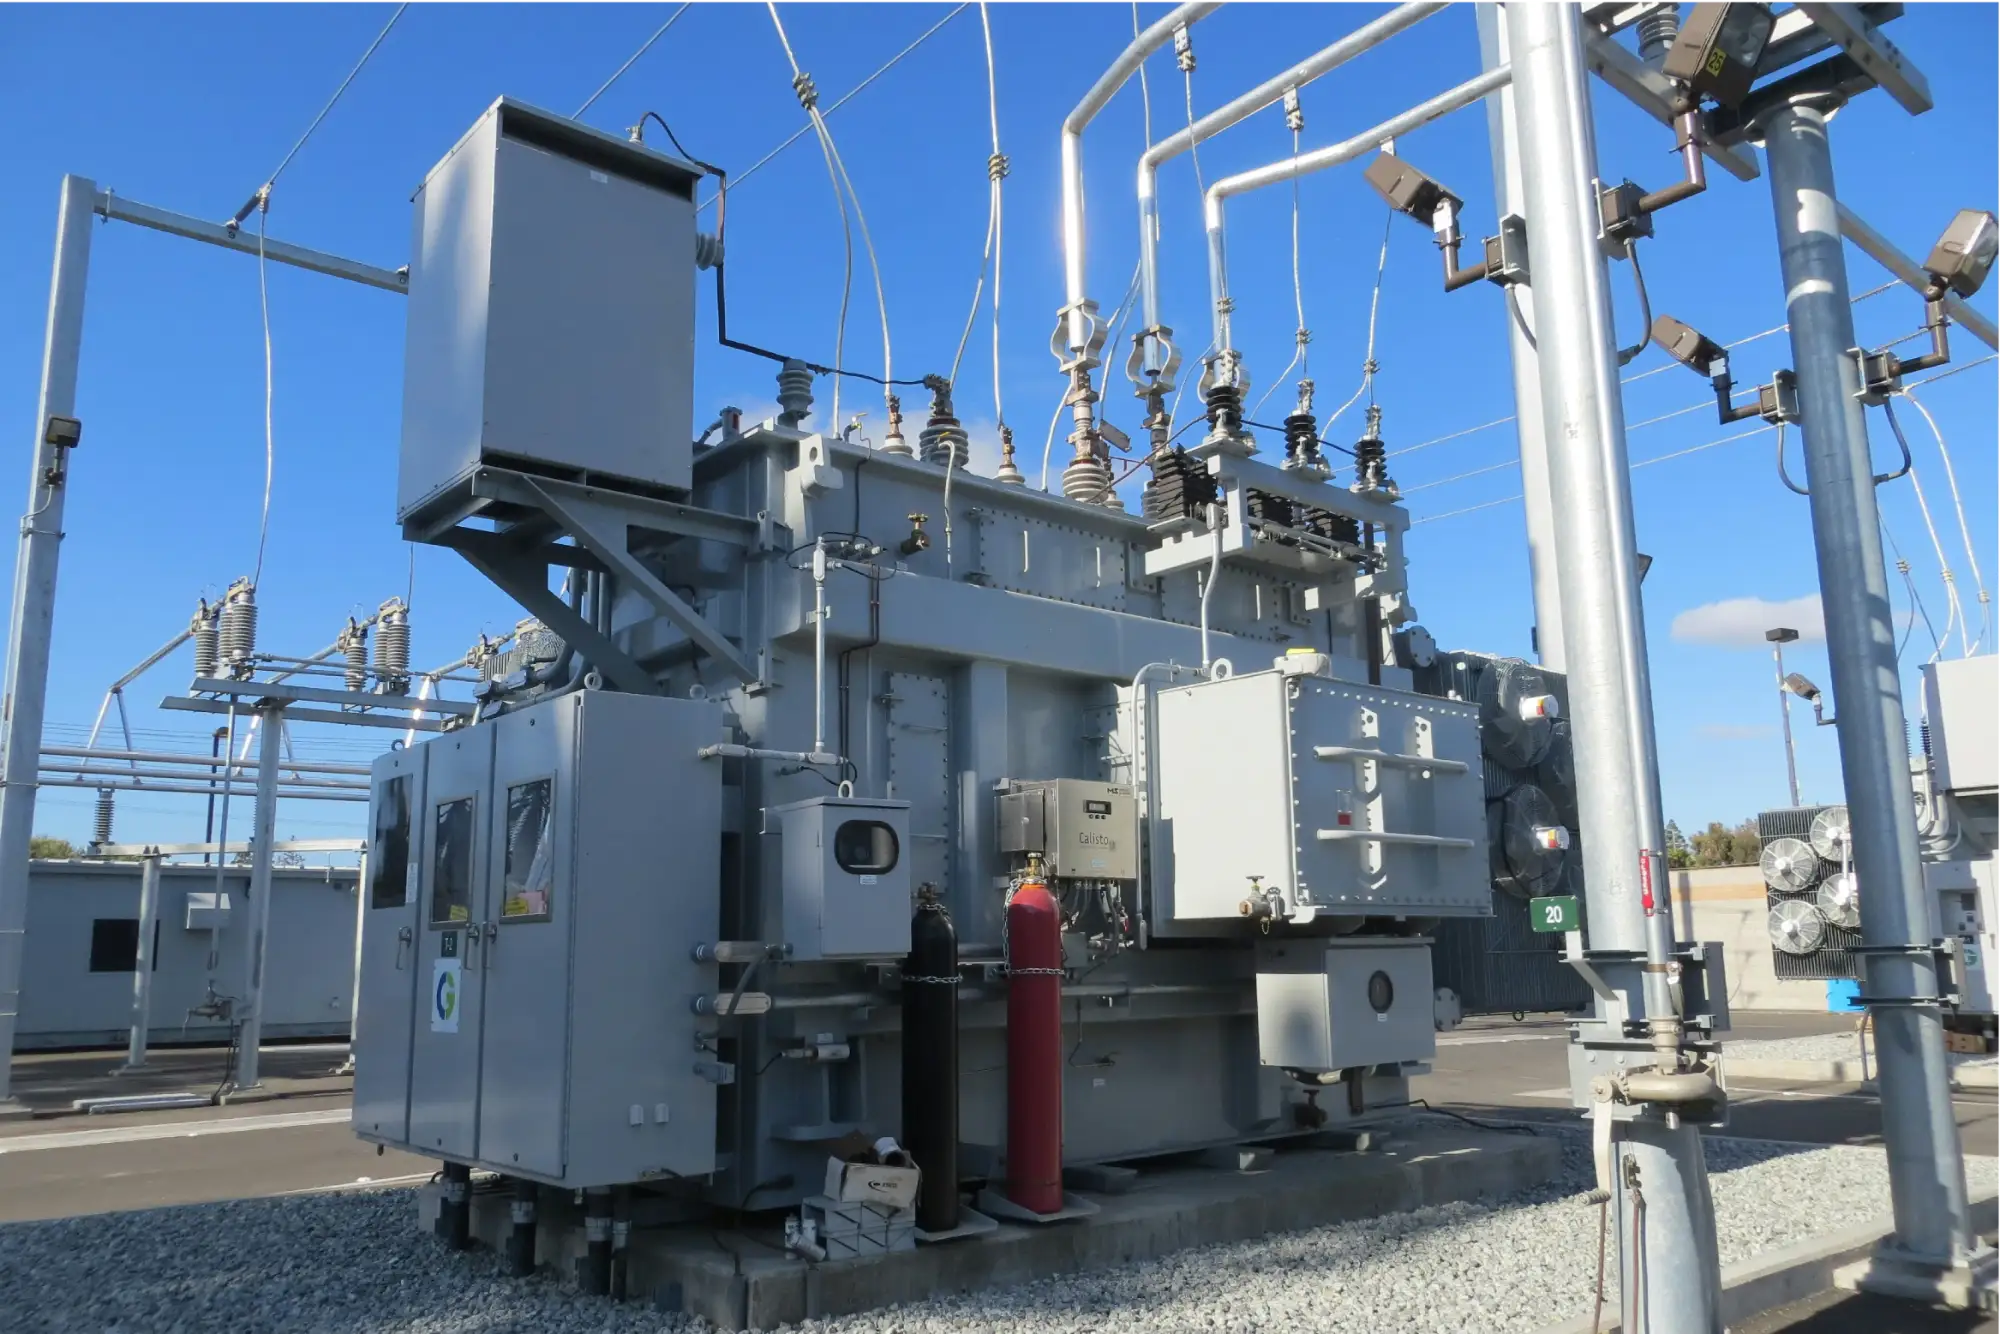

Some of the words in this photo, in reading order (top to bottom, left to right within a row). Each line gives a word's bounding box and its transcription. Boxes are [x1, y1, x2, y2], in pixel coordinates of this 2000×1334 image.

[1709, 51, 1723, 71] 25
[1079, 831, 1109, 846] Calisto
[1545, 905, 1562, 923] 20
